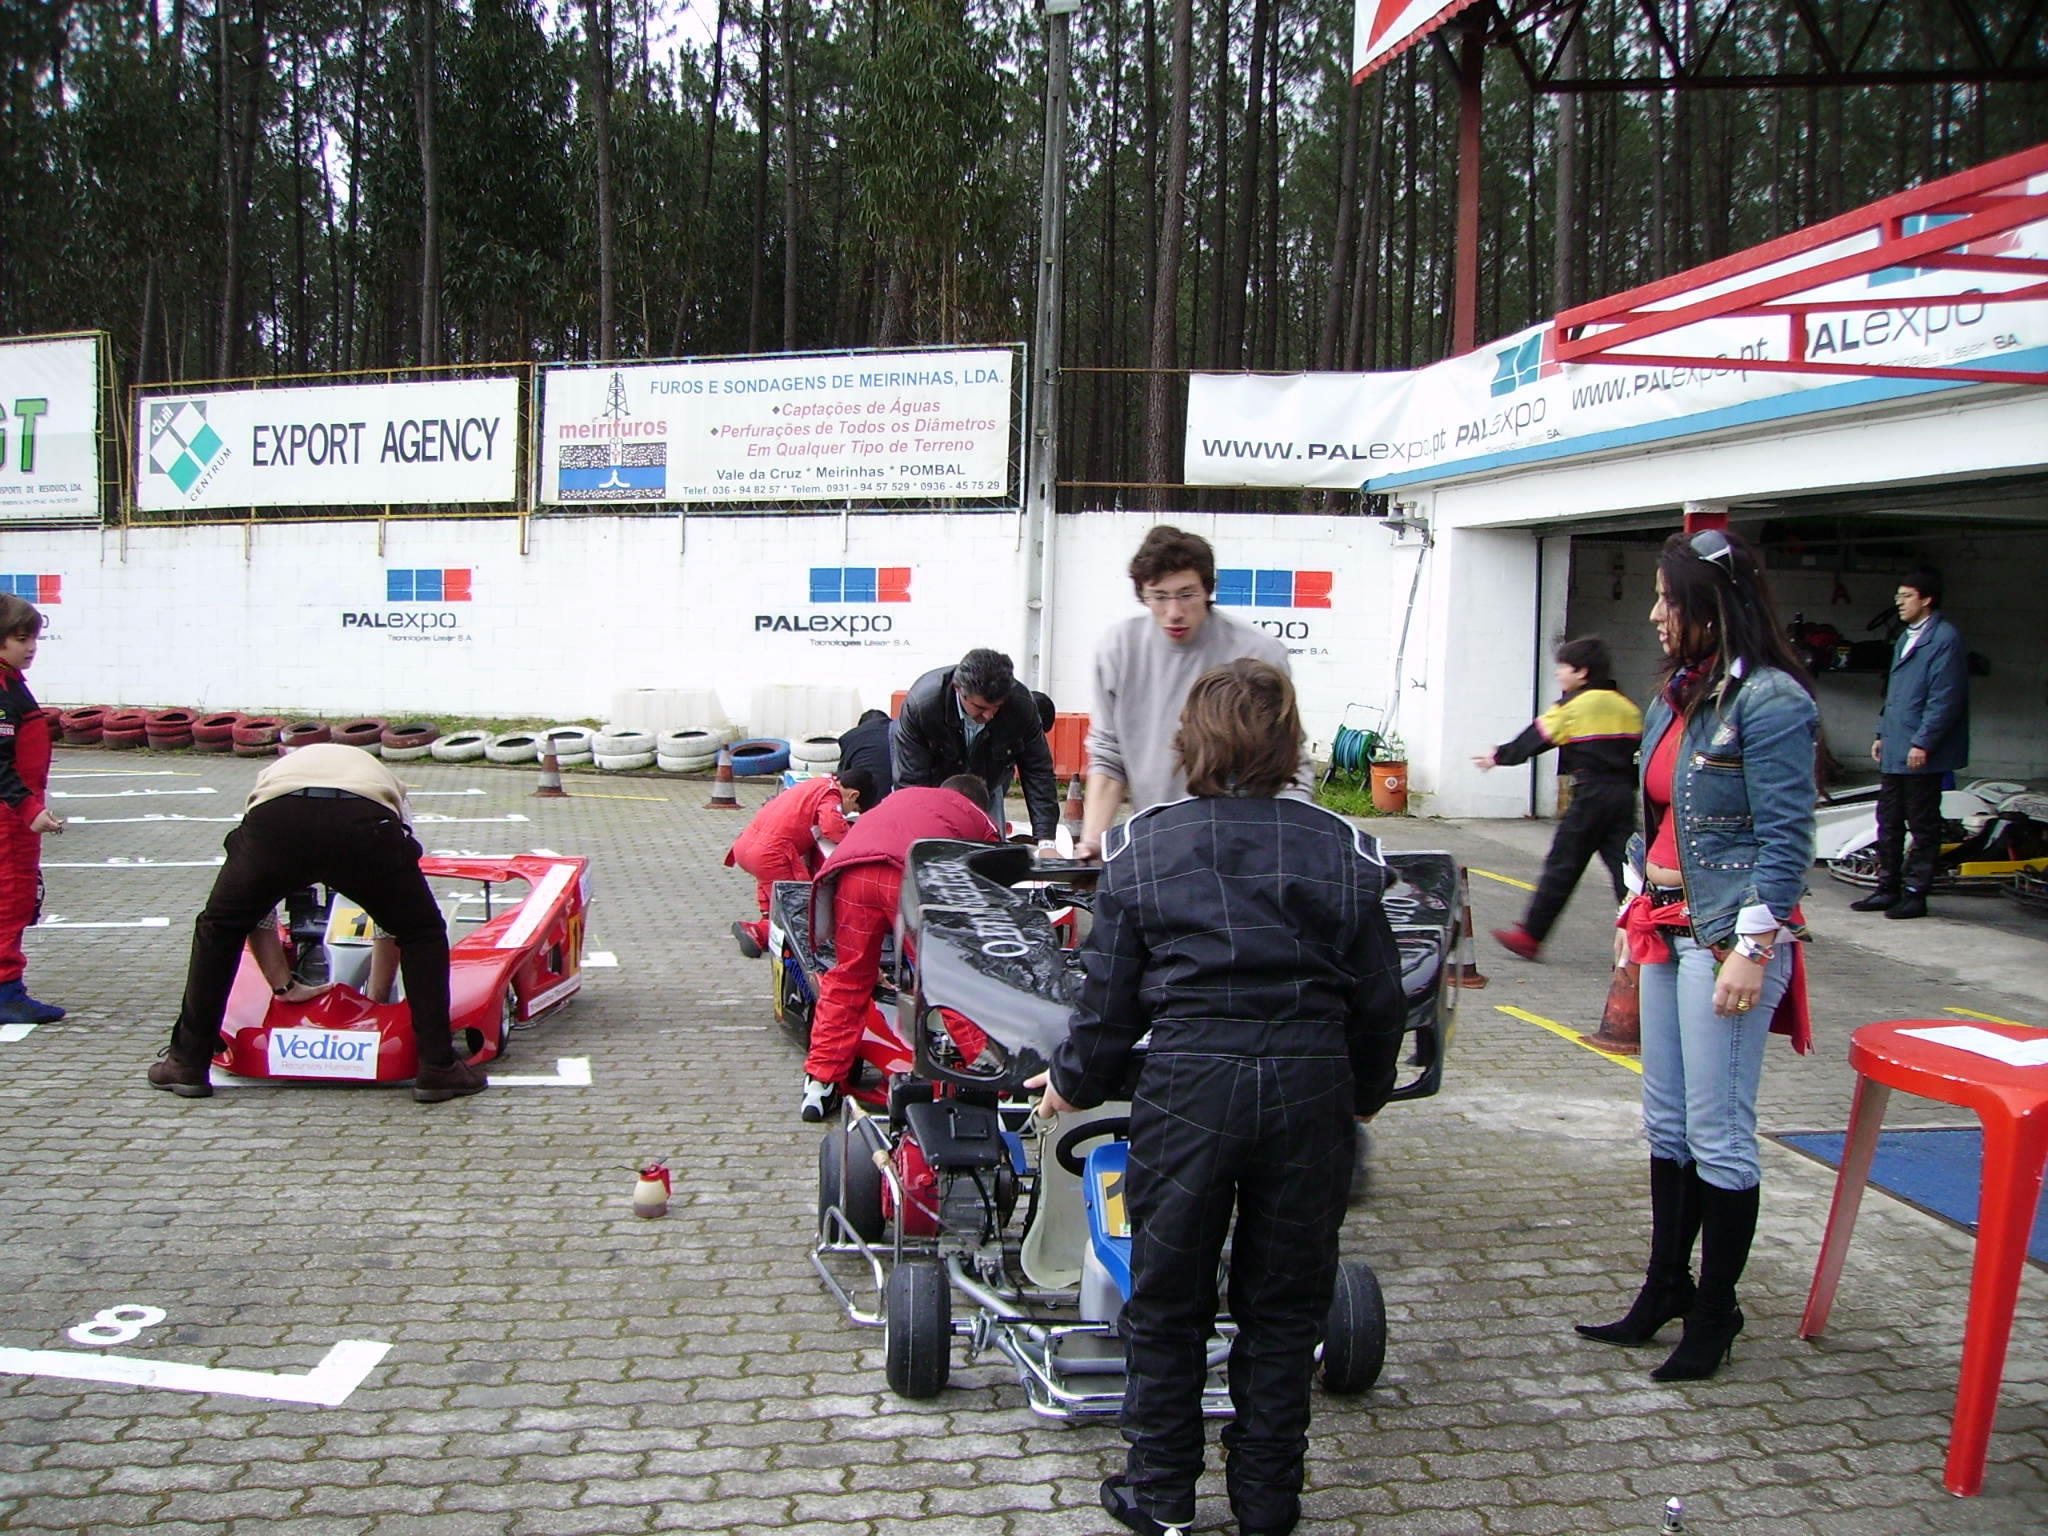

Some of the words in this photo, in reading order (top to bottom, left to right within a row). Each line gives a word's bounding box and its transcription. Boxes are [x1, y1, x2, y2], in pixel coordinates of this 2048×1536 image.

[1805, 288, 1985, 358] ALexpo
[650, 380, 703, 394] FUROS
[709, 380, 719, 394] E
[723, 375, 826, 394] SONDAGENS
[832, 374, 854, 388] DE
[860, 371, 959, 388] MEIRINHAS,
[965, 369, 1004, 384] LDA.
[782, 402, 862, 419] Captações
[867, 401, 885, 414] de
[890, 397, 941, 417] Águas
[559, 417, 668, 438] meirifuros
[720, 423, 811, 438] Perfurações
[815, 421, 833, 435] de
[839, 420, 885, 435] Todos
[891, 422, 910, 433] os
[914, 418, 996, 433] Diâmetros
[1456, 398, 1546, 448] PALexpo
[252, 422, 367, 466] EXPORT
[380, 417, 500, 463] AGENCY
[747, 443, 771, 457] Em
[776, 441, 845, 458] Qualquer
[851, 440, 884, 456] Tipo
[889, 440, 908, 453] de
[914, 439, 974, 453] Terreno
[190, 447, 233, 502] CENTRUM
[717, 469, 744, 480] Vale
[749, 469, 766, 480] da
[770, 468, 802, 480] Cruz
[816, 466, 885, 478] Meirinhas
[900, 464, 966, 476] POMBAL
[683, 486, 710, 495] Telef.
[713, 486, 730, 495] 036
[739, 486, 751, 494] 94
[754, 485, 766, 494] 82
[769, 485, 780, 494] 57
[791, 484, 823, 494] Telem.
[826, 483, 849, 492] 0931
[860, 483, 872, 491] 94
[876, 482, 888, 491] 57
[892, 482, 910, 491] 529
[920, 482, 945, 491] 0936
[956, 481, 968, 490] 45
[972, 481, 984, 490] 75
[987, 480, 1000, 490] 29
[342, 612, 457, 633] PALexpo
[755, 615, 892, 637] PALexpo
[351, 912, 369, 937] 1
[275, 1033, 373, 1062] Vedior
[67, 1304, 168, 1346] 8
